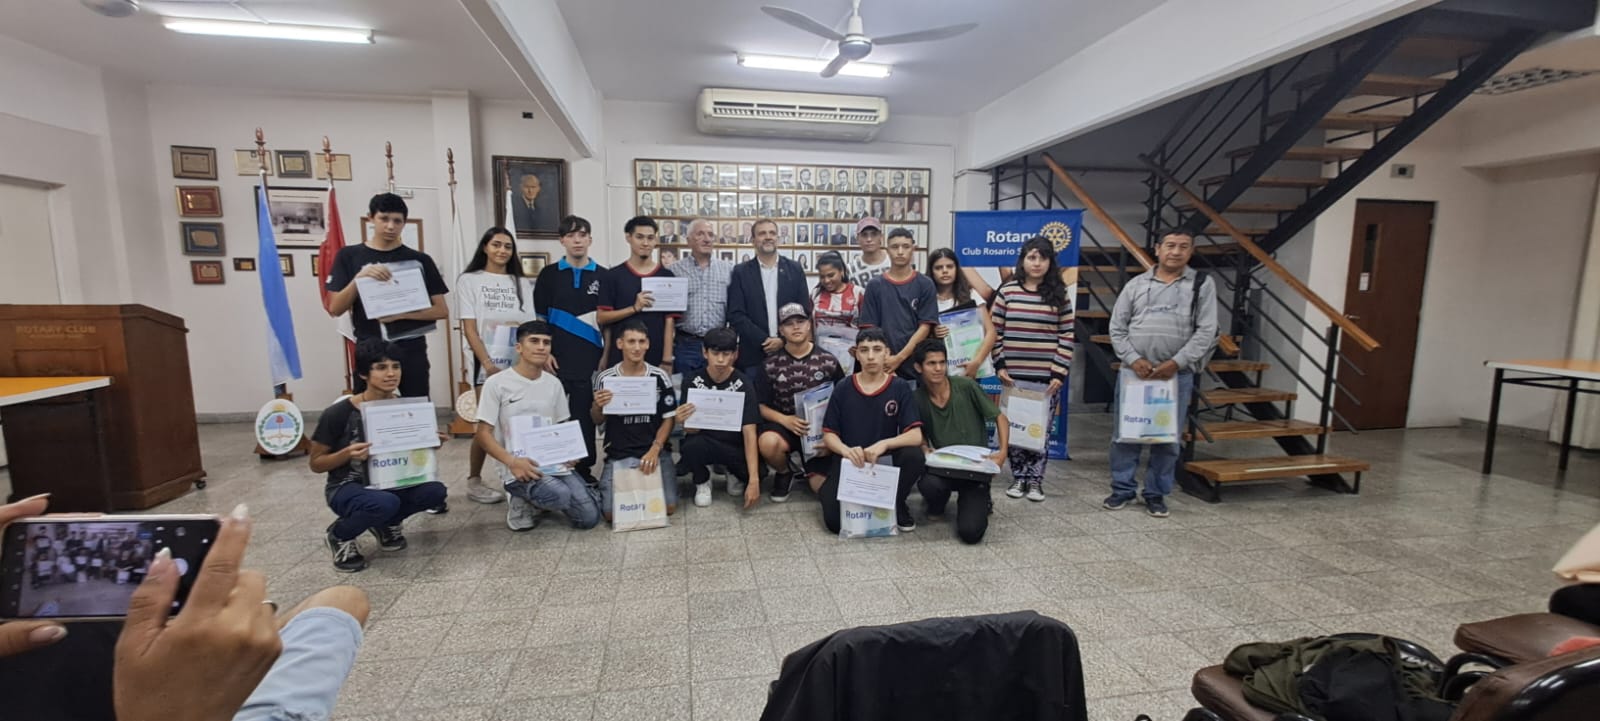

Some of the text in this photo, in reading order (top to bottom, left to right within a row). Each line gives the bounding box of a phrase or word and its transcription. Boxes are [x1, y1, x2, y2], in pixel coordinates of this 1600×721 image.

[986, 230, 1036, 243] Rotary
[962, 247, 981, 256] Club
[983, 247, 1016, 256] Rosario
[15, 325, 97, 334] ROTARY CLUB
[489, 357, 513, 366] otary
[1124, 415, 1152, 425] Rotary
[372, 456, 409, 468] Rotary
[619, 503, 646, 512] Rotary
[845, 510, 873, 520] Rotary
